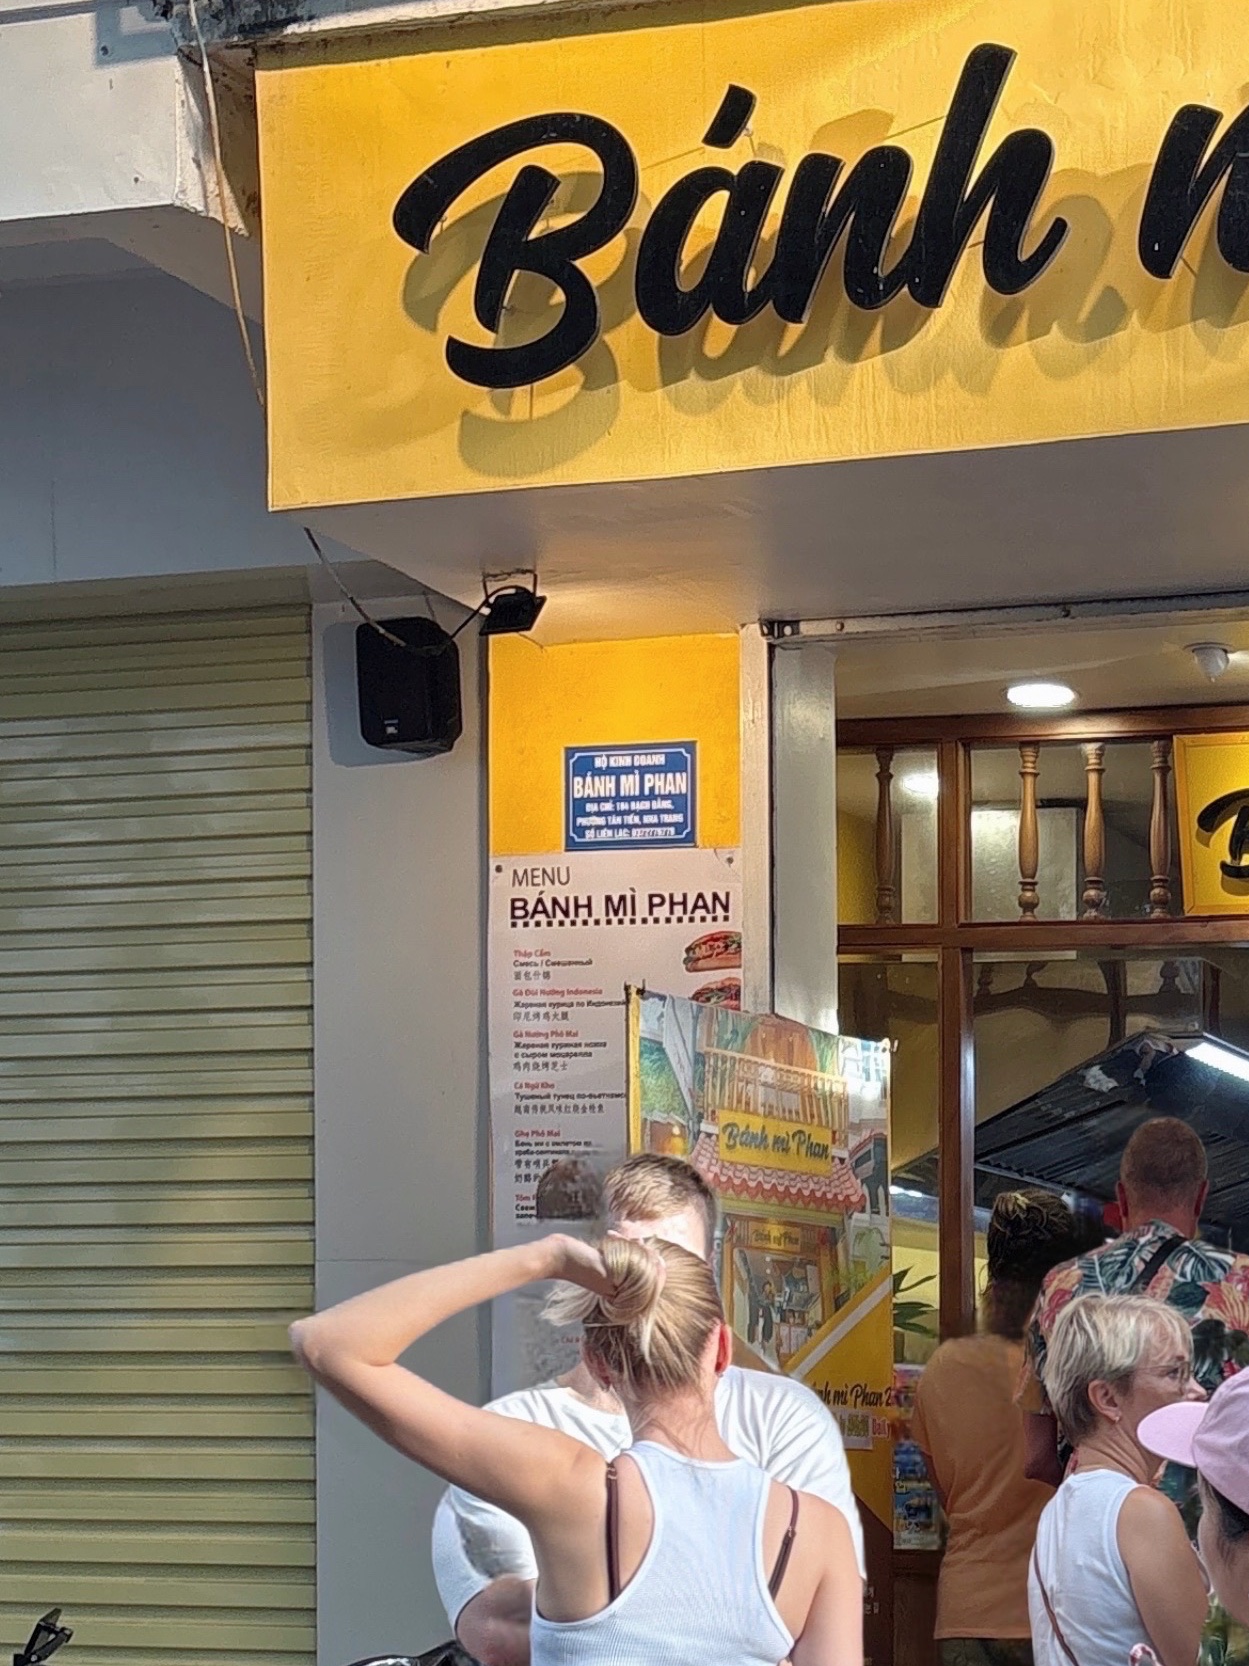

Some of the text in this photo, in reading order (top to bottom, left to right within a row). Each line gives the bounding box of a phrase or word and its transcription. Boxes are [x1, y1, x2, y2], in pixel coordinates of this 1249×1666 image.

[393, 42, 1068, 389] Bánh
[633, 754, 665, 766] DOANH
[573, 769, 687, 798] BÁNH MÌ PHAN
[512, 866, 571, 887] MENU
[510, 887, 730, 919] BÁNH MÌ PHAN
[722, 1122, 769, 1150] Bánh
[792, 1129, 829, 1161] Phan
[850, 1383, 883, 1408] Phan
